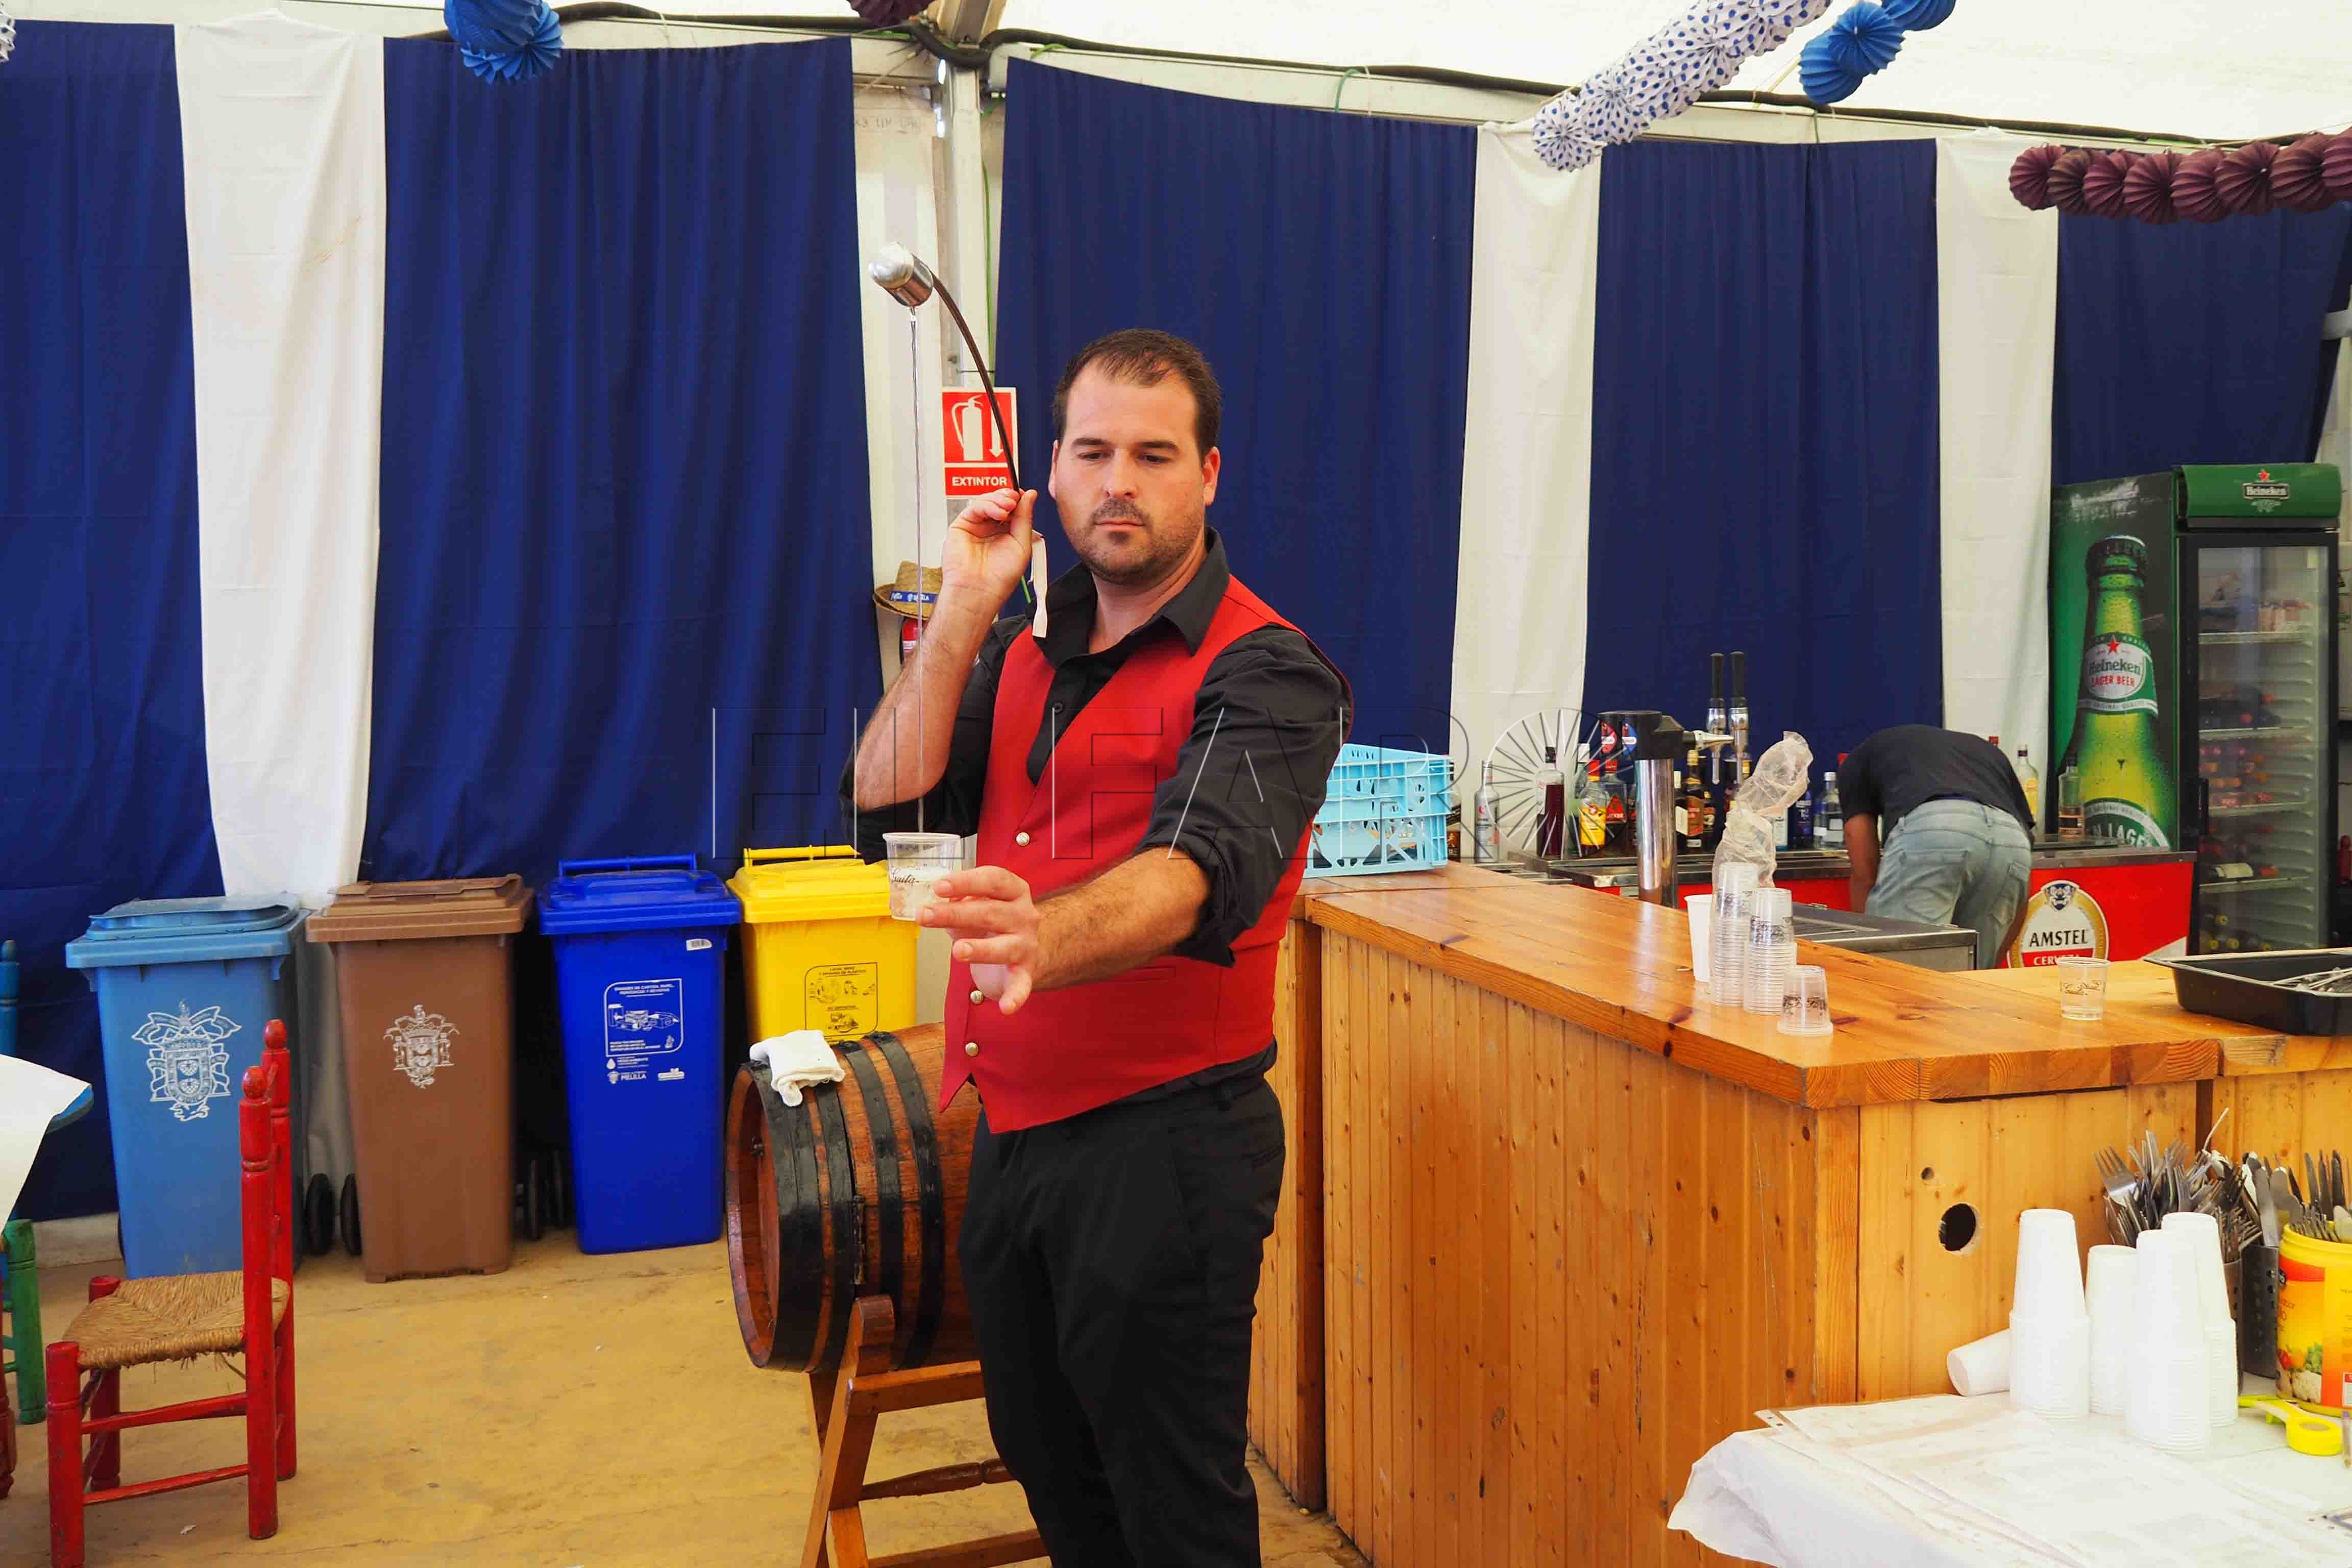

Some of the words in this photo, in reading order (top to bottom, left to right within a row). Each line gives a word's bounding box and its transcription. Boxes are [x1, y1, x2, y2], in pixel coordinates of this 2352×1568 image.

[951, 476, 1008, 486] EXTINTOR
[2246, 486, 2287, 496] Heineken
[2090, 658, 2140, 675] Heineken
[2091, 675, 2114, 688] LAGER
[2116, 675, 2136, 687] BEER
[2108, 823, 2152, 848] LAGE
[2029, 929, 2088, 947] AMSTEL
[2033, 953, 2079, 966] CERV
